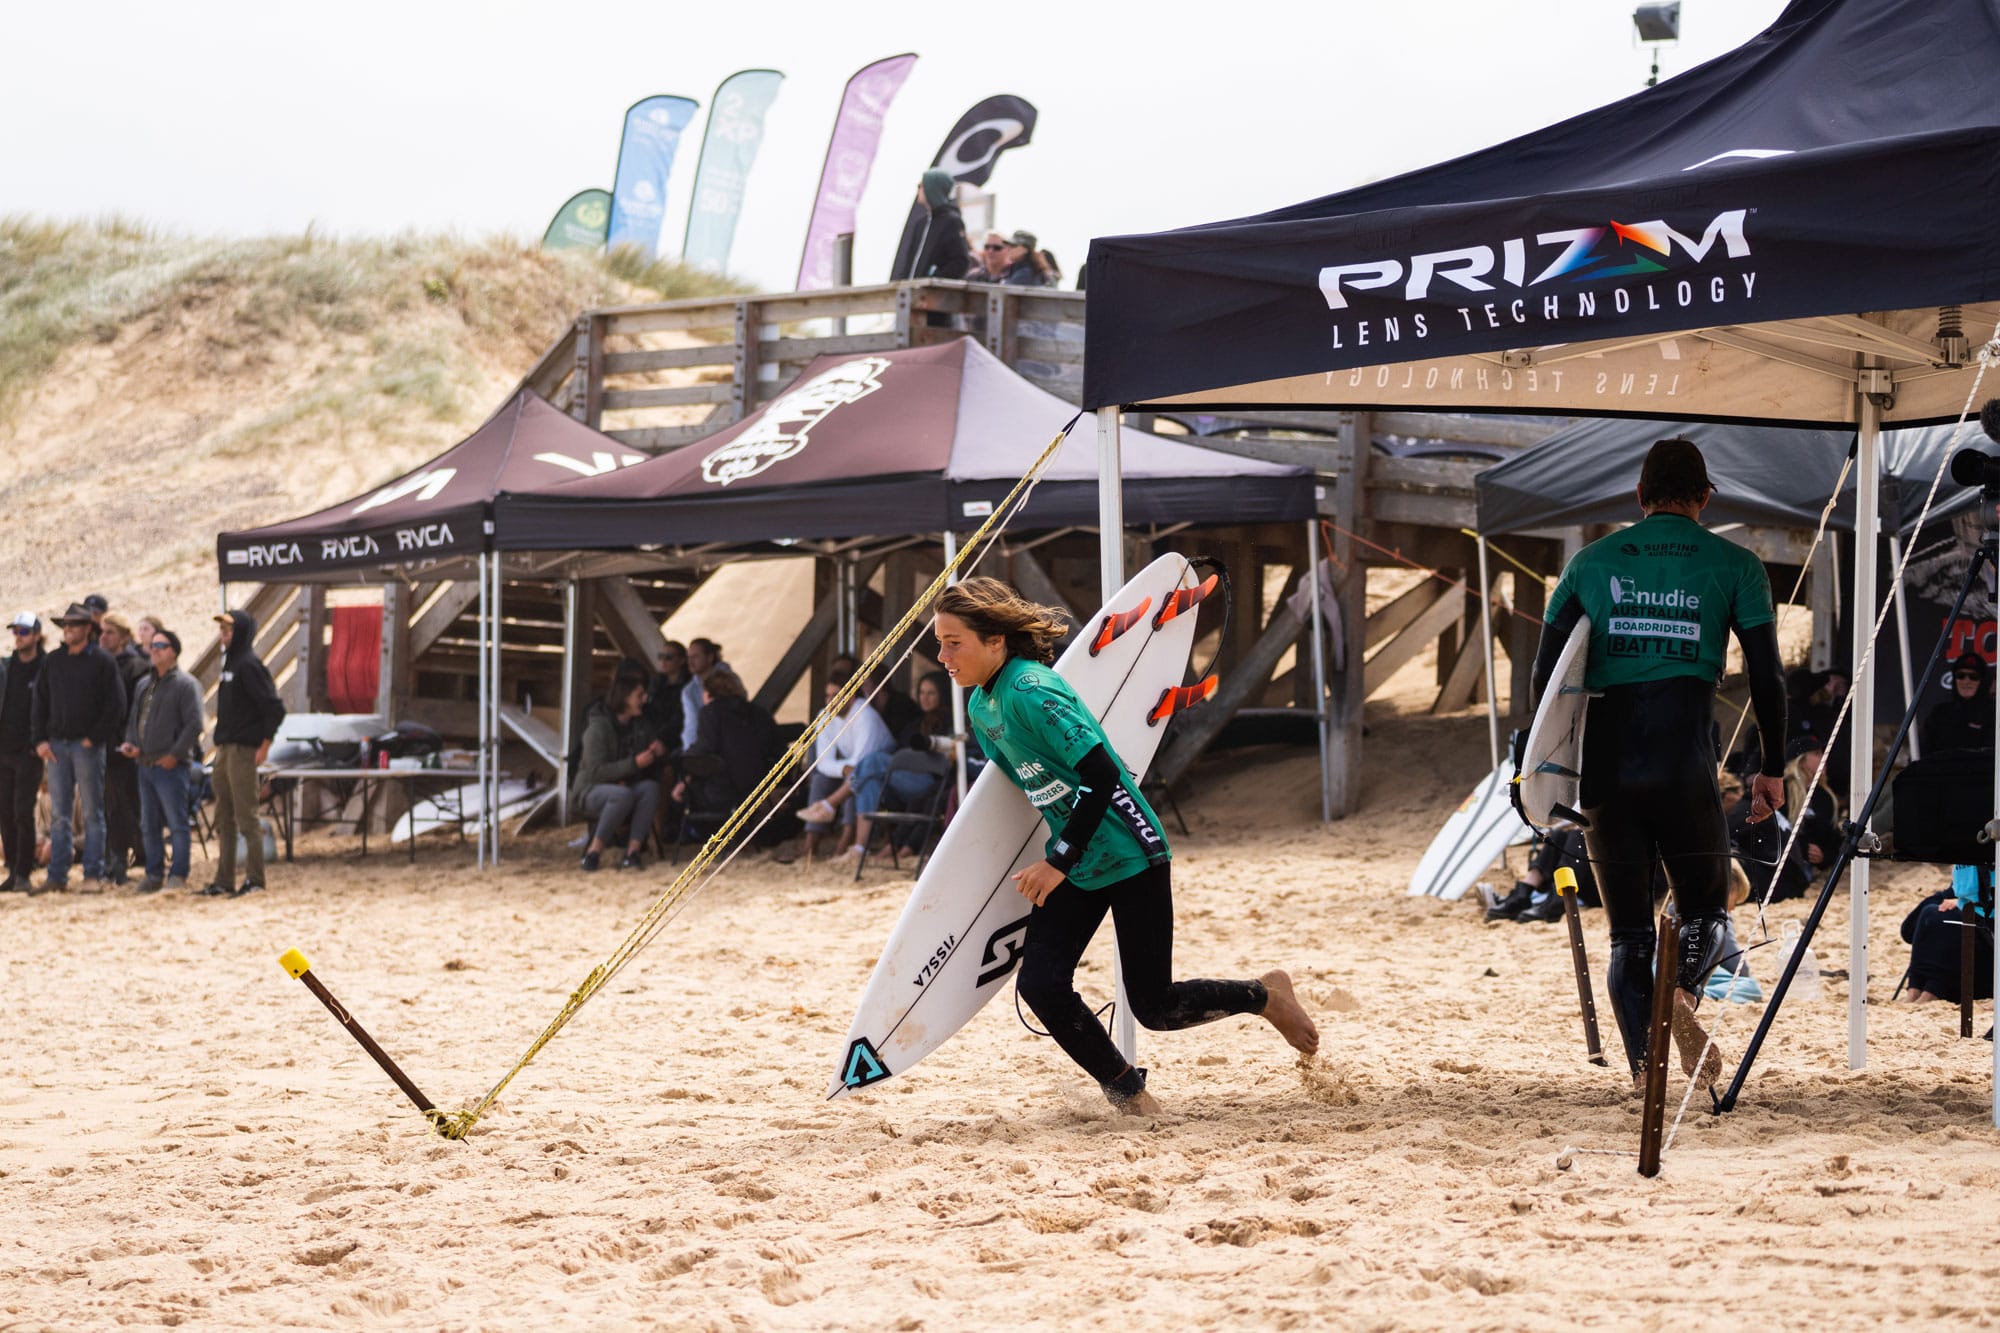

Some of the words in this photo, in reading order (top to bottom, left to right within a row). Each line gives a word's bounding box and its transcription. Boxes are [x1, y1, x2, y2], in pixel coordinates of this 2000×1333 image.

[1318, 209, 1751, 310] PRIZM
[1333, 313, 1429, 349] LENS
[1457, 272, 1756, 332] TECHNOLOGY
[250, 543, 303, 568] RVCA
[321, 535, 379, 560] RVCA
[396, 523, 454, 551] RVCA
[1643, 543, 1699, 553] SURFING
[1637, 589, 1700, 609] nudie
[1610, 605, 1702, 622] AUSTRALIAN
[1614, 621, 1695, 636] BOARDRIDERS
[1612, 636, 1694, 658] BATTLE
